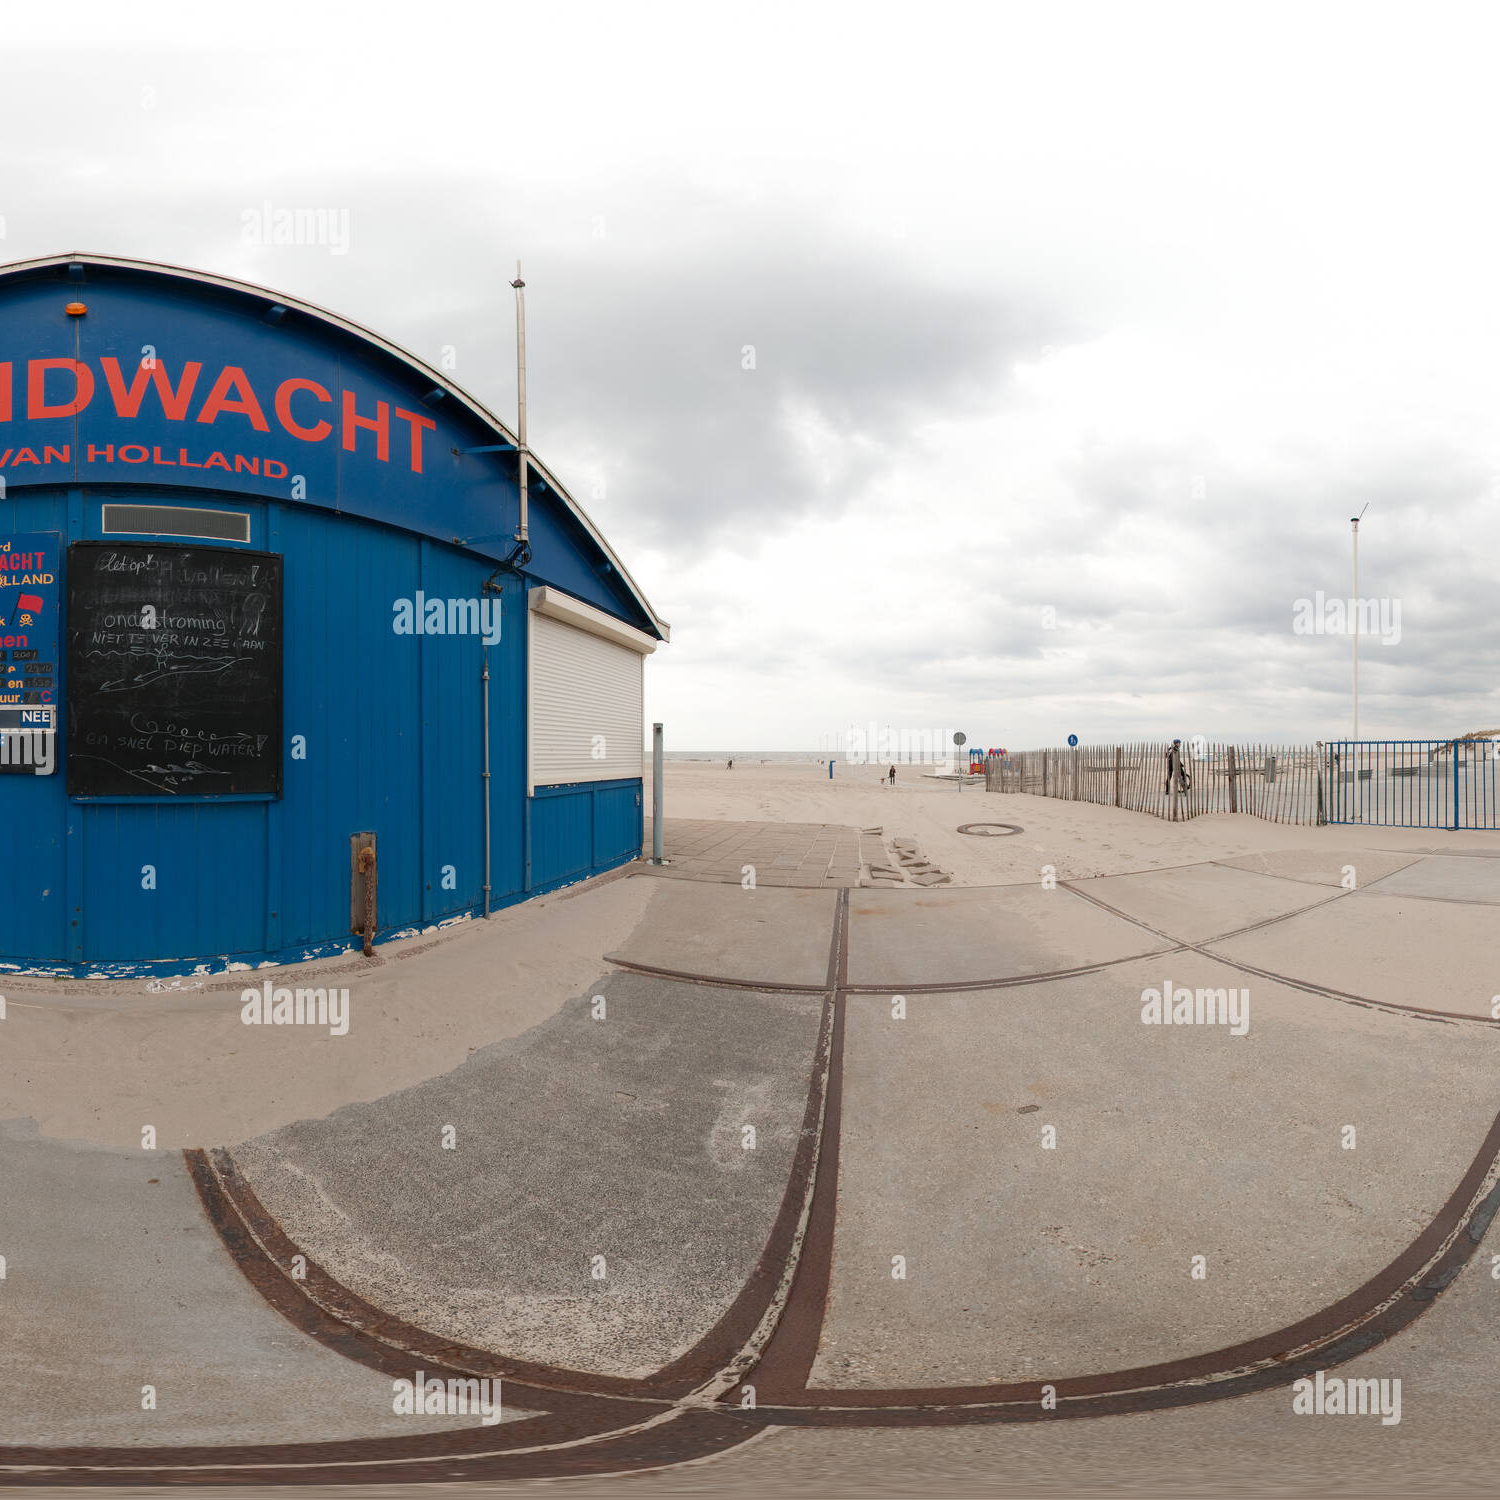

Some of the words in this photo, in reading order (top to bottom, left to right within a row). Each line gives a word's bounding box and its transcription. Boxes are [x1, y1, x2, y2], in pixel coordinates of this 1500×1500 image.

[87, 444, 288, 479] HOLLAND
[153, 634, 179, 645] VER
[184, 635, 199, 645] IN
[8, 680, 24, 689] en
[22, 710, 50, 723] NEE
